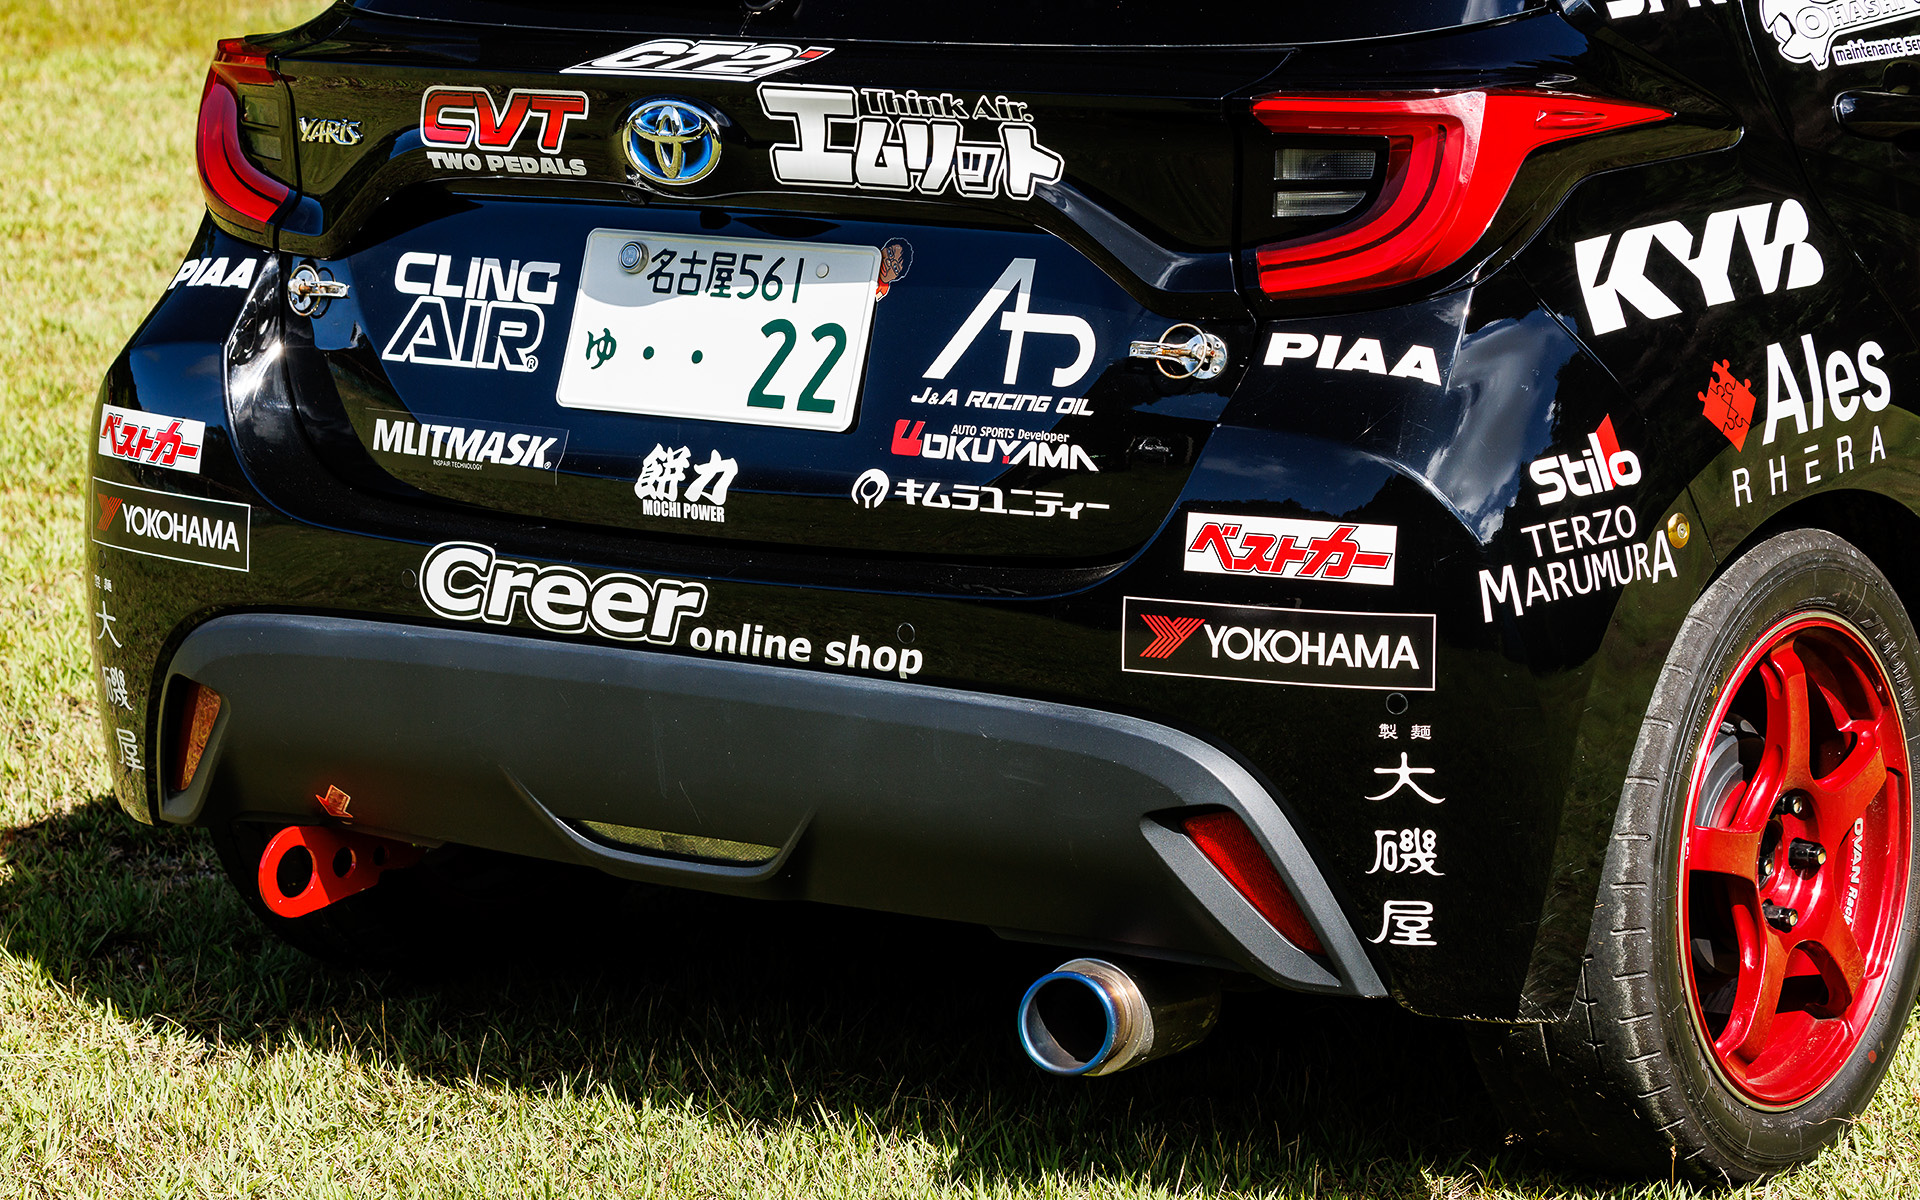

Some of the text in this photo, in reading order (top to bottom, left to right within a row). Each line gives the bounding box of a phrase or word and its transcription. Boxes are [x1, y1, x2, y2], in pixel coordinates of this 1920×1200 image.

[1835, 40, 1903, 62] maintenance
[421, 86, 588, 154] CVT
[861, 88, 1034, 122] Think Air.
[427, 151, 588, 176] TWO PEDALS
[757, 83, 1065, 200] エムリット
[168, 257, 257, 290] PIAA
[394, 251, 561, 305] CLING
[1574, 198, 1824, 336] KYB
[585, 327, 617, 370] ゆ
[746, 318, 848, 414] 22
[1263, 332, 1442, 386] PIAA
[911, 386, 1095, 416] J&A RACING OIL
[1762, 334, 1891, 447] Ales
[100, 412, 201, 467] ベストカー
[921, 433, 1100, 472] OKUYAMA
[951, 423, 1070, 443] AUTO SPORTS Developer
[452, 461, 483, 471] TECHNOLOGY
[1731, 425, 1887, 508] RHERA
[642, 499, 725, 523] MOCHI POWER
[895, 478, 1110, 520] キムラユニティー
[122, 503, 240, 553] YOKOHAMA
[1189, 522, 1393, 580] ベストカー
[1520, 505, 1637, 558] TERZO
[1478, 529, 1678, 624] MARUMURA
[420, 542, 924, 679] Creer online shop
[1203, 623, 1420, 670] YOKOHAMA
[1874, 623, 1920, 722] YOKOHAMA
